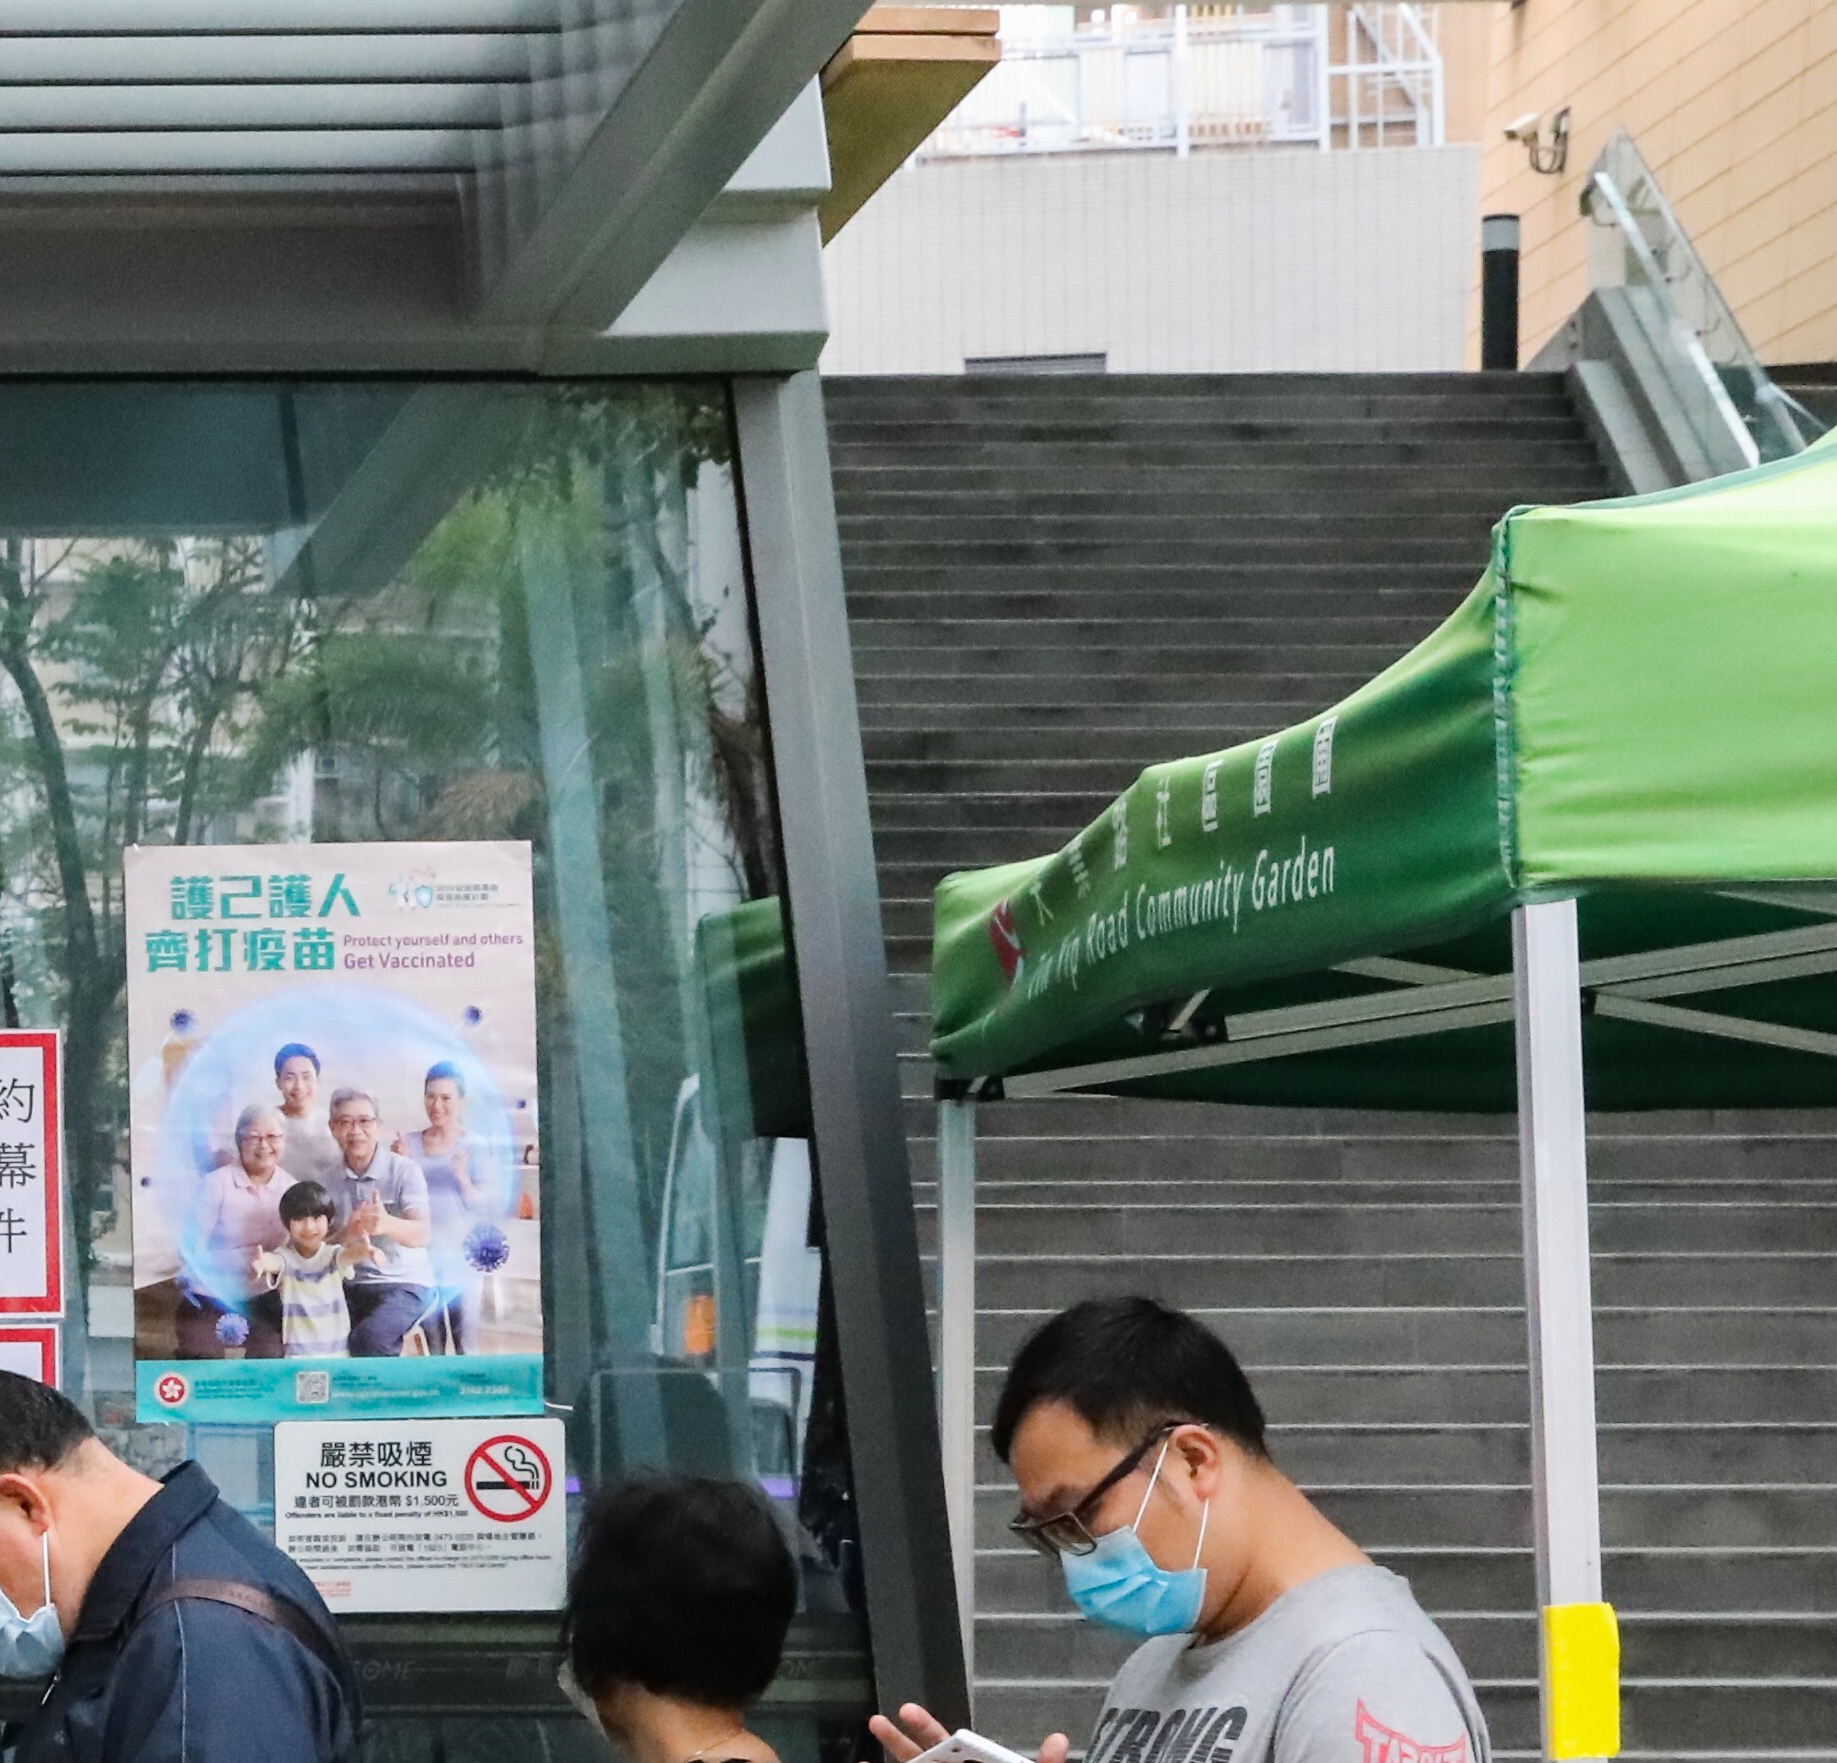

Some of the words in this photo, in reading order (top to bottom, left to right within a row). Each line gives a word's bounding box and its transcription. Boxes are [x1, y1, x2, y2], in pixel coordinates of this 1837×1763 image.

[170, 873, 360, 920] 護己護人
[1136, 860, 1245, 940] Community
[1251, 835, 1335, 912] Garden
[146, 927, 335, 973] 齊打疫苗
[342, 934, 392, 948] Protect
[395, 933, 450, 951] yourself
[452, 933, 477, 946] and
[480, 933, 524, 945] others
[343, 952, 375, 970] Get
[378, 952, 475, 969] Vaccinated
[320, 1441, 432, 1468] 嚴禁吸煙
[306, 1471, 338, 1489] NO
[344, 1470, 447, 1489] SMOKING
